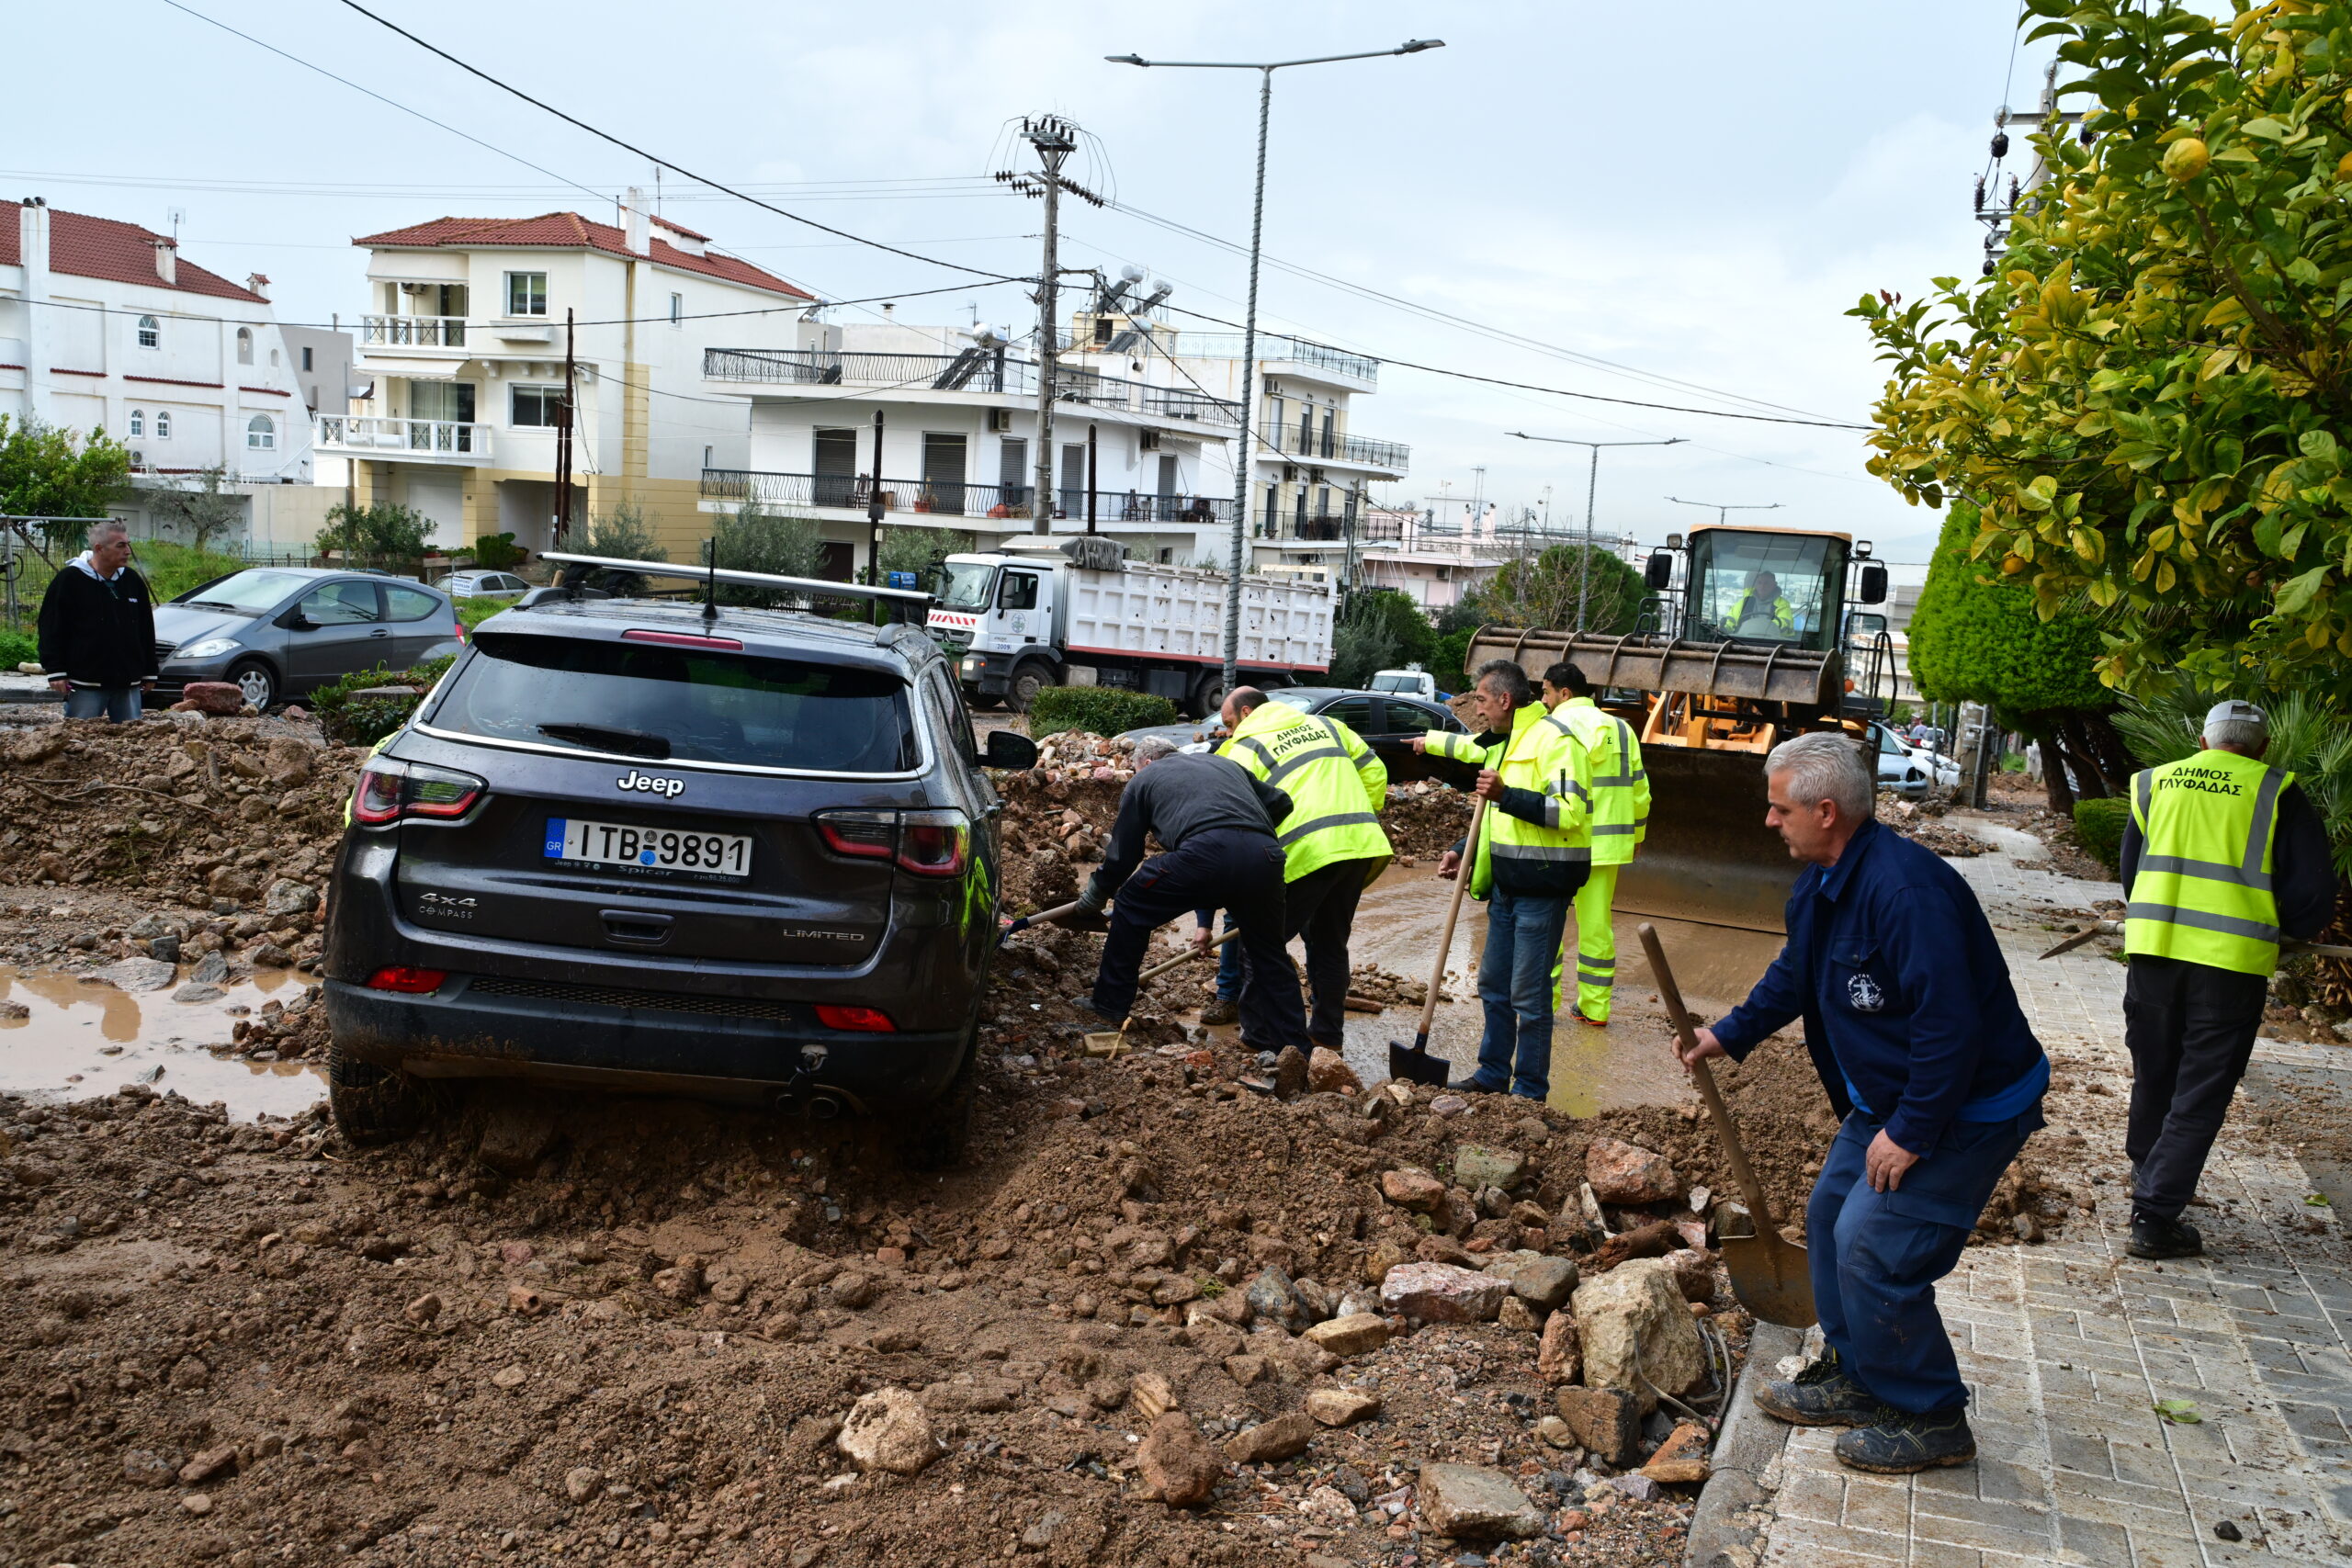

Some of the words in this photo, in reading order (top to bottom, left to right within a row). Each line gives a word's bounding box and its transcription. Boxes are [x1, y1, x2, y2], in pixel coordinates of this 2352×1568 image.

[1277, 724, 1314, 741] ΔΗΜΟΣ
[1272, 730, 1330, 756] ΓΛΥΦΑΔΑΣ
[2172, 767, 2233, 781] ΔΗΜΟΣ
[617, 770, 685, 798] Jeep
[2159, 778, 2242, 795] ΓΛΥΦΑΔΑΣ
[547, 841, 561, 852] GR
[618, 864, 675, 876] Spicar
[420, 893, 478, 908] 4x4
[419, 905, 473, 919] COMPASS
[783, 929, 865, 942] LIMITED
